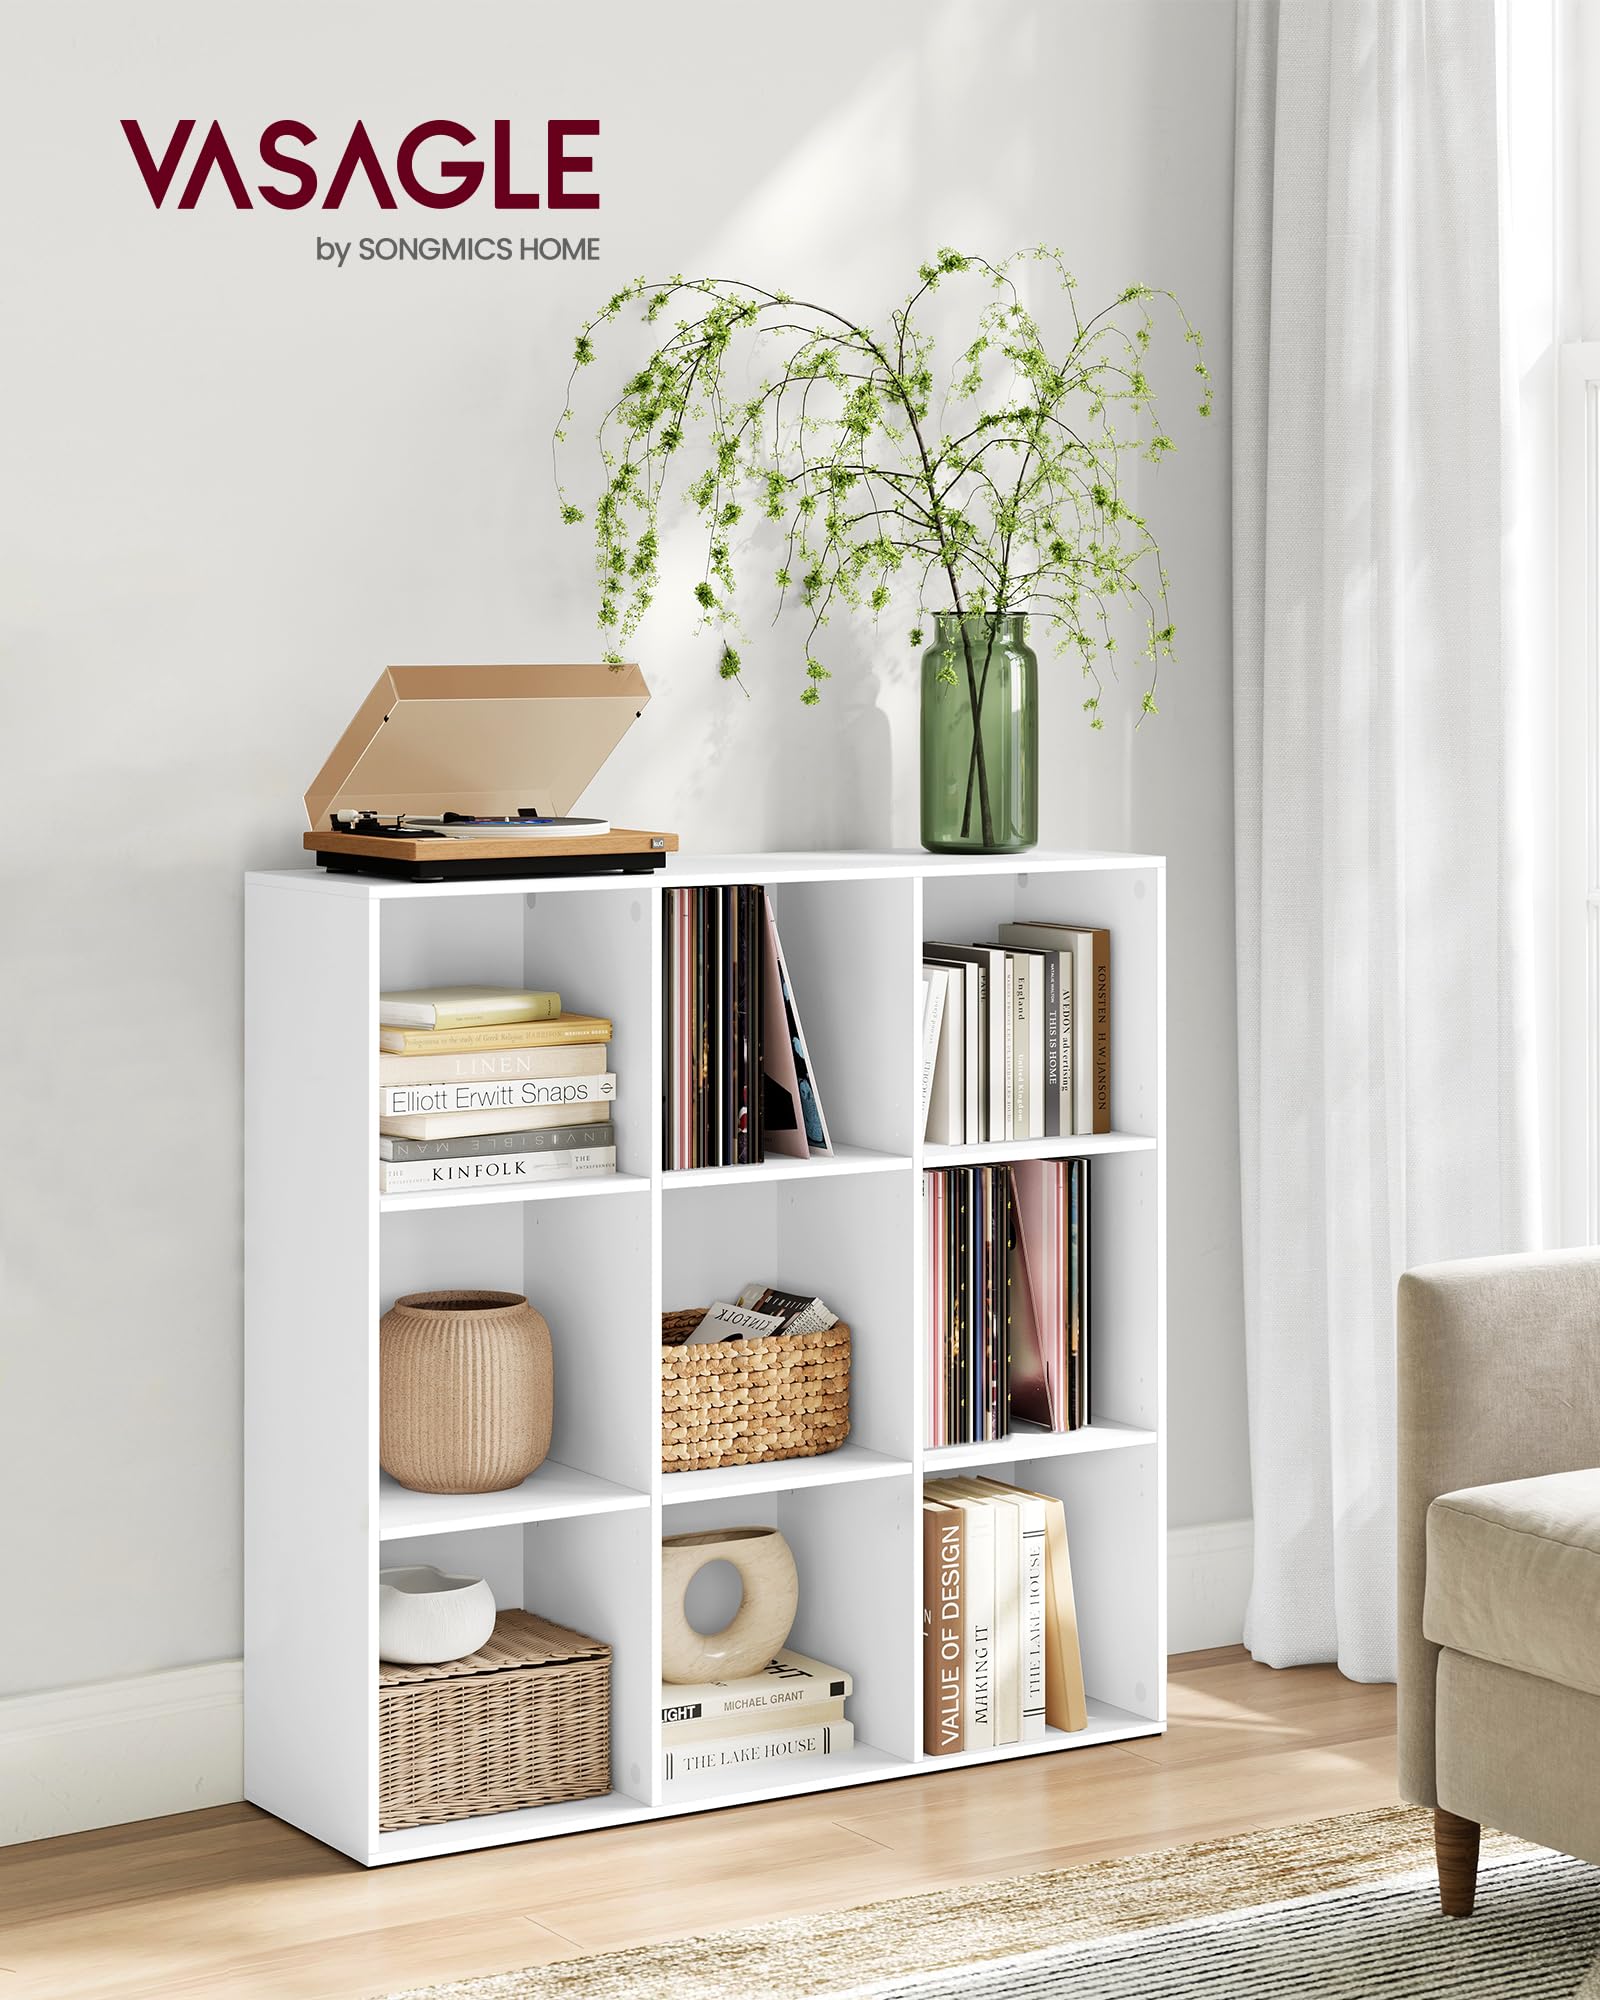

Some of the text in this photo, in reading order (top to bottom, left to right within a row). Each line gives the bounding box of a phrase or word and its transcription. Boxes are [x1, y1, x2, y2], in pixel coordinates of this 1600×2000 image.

[1017, 977, 1025, 1021] England
[1098, 965, 1106, 1024] KONSTEN
[1049, 1011, 1057, 1084] THIS IS HOME
[1062, 989, 1071, 1092] AVEDON advertising
[456, 1055, 532, 1076] LINEN
[392, 1082, 588, 1113] Elliott Erwitt Snaps
[397, 1142, 449, 1155] MAN
[432, 1161, 527, 1181] KINFOLK
[1029, 1546, 1041, 1606] HOUSE
[941, 1525, 960, 1746] VALUE OF DESIGN
[975, 1624, 988, 1725] MAKING IT
[1029, 1659, 1041, 1698] THE
[723, 1690, 804, 1711] MICHAEL GRANT
[683, 1737, 816, 1771] THE LAKE HOUSE
